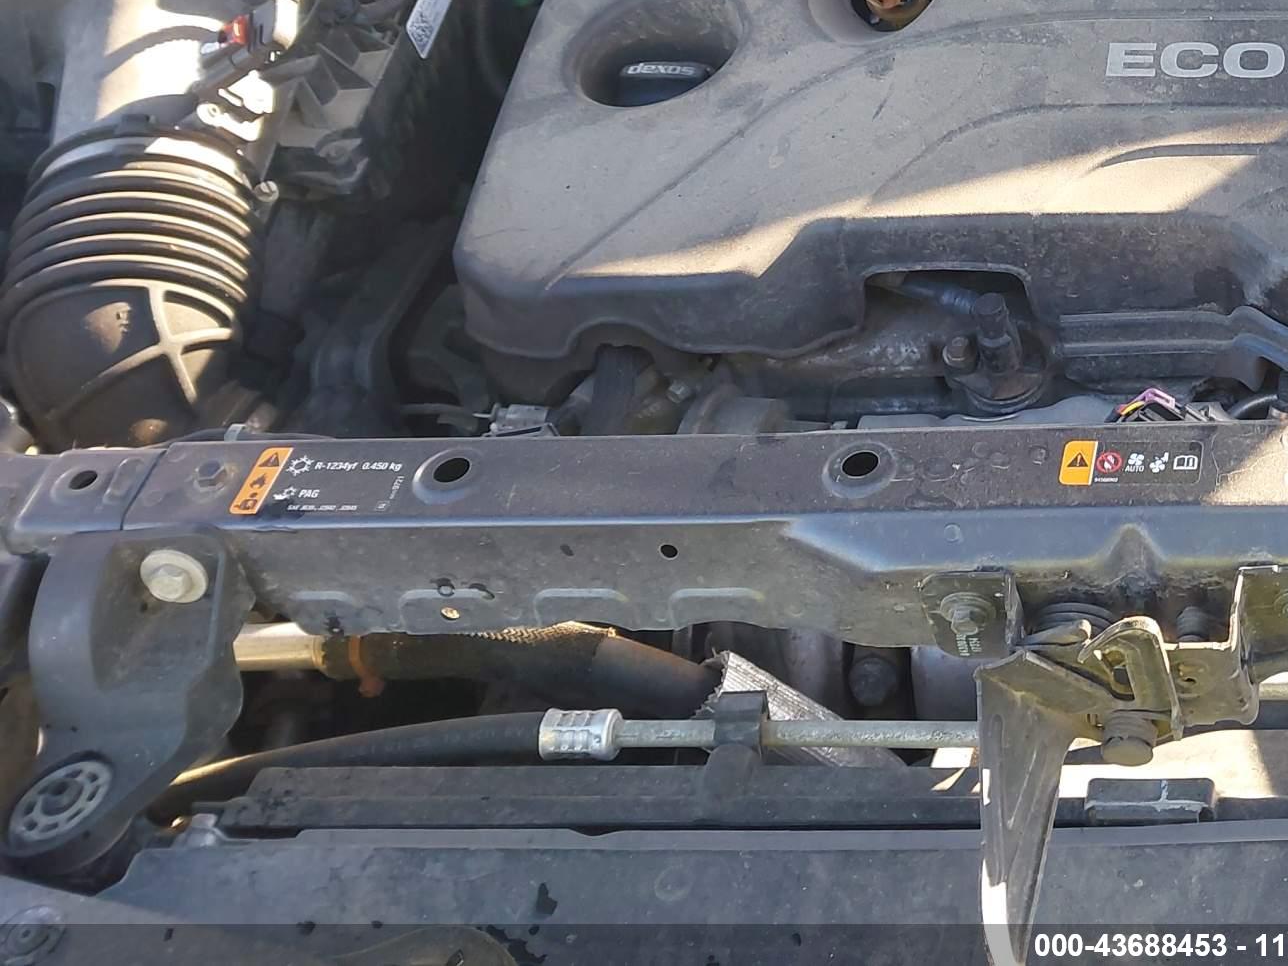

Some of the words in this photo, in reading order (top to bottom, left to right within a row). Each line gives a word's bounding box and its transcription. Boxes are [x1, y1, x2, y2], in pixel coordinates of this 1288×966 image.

[627, 62, 695, 75] dexos
[314, 461, 358, 471] R-1234yf
[362, 461, 388, 470] 0.450
[389, 461, 402, 471] kg
[298, 489, 320, 498] PAG
